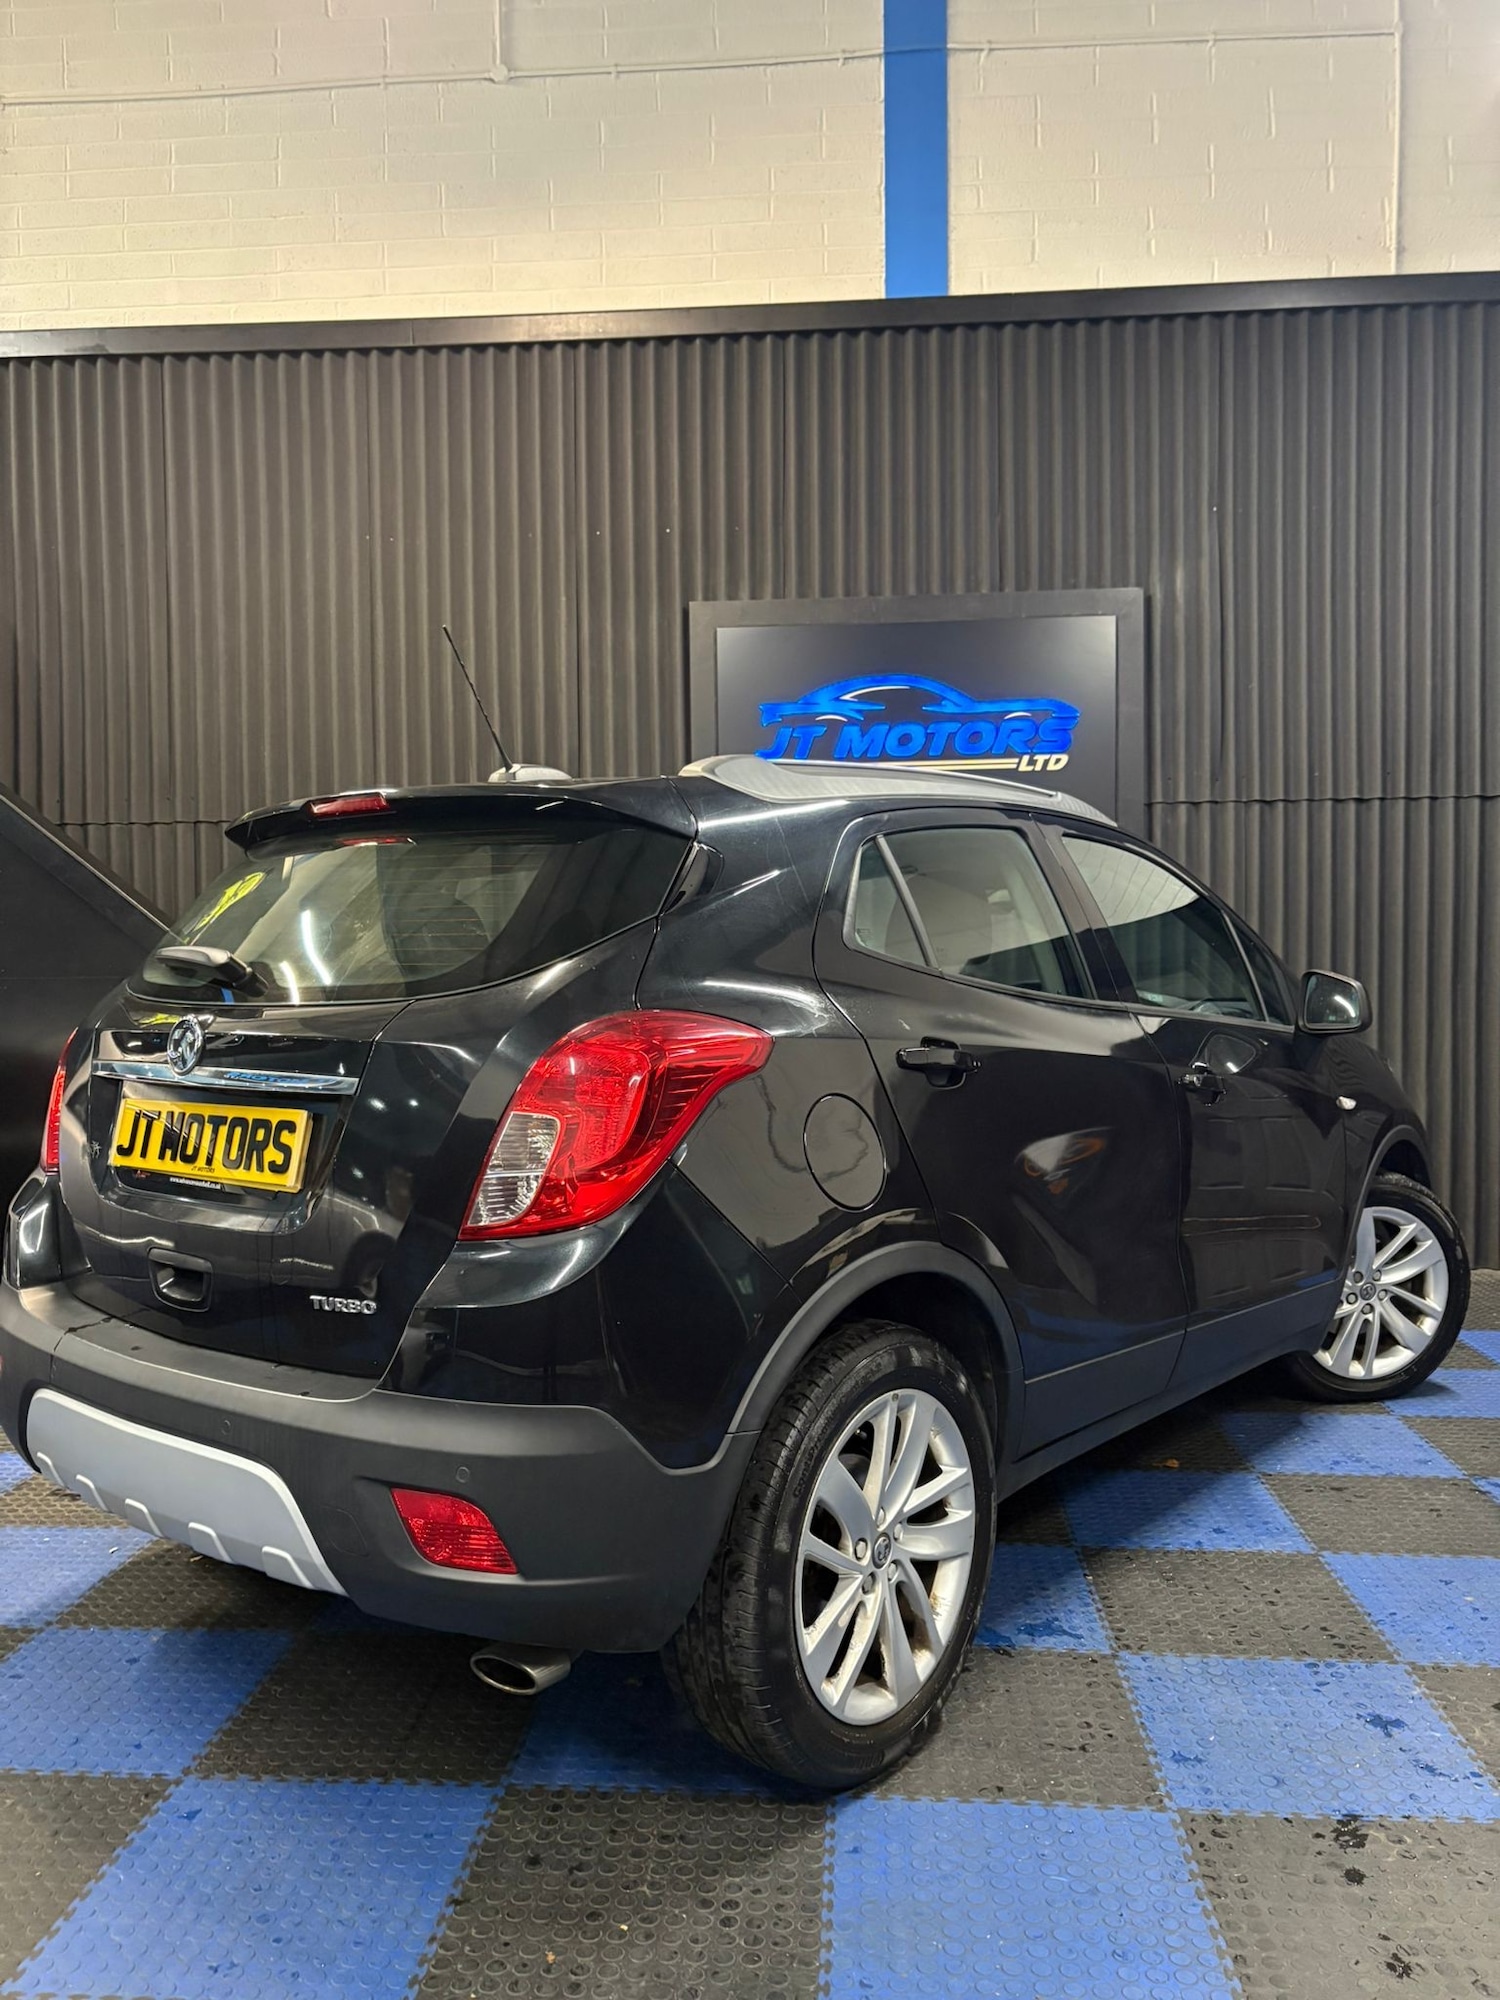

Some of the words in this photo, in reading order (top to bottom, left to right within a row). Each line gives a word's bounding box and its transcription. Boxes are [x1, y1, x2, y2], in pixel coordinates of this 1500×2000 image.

[755, 726, 827, 759] JT
[833, 717, 1080, 759] MOTORS
[1017, 754, 1069, 772] LTD
[116, 1108, 160, 1159] JT
[158, 1111, 297, 1175] MOTORS
[309, 1295, 377, 1315] TURBO
